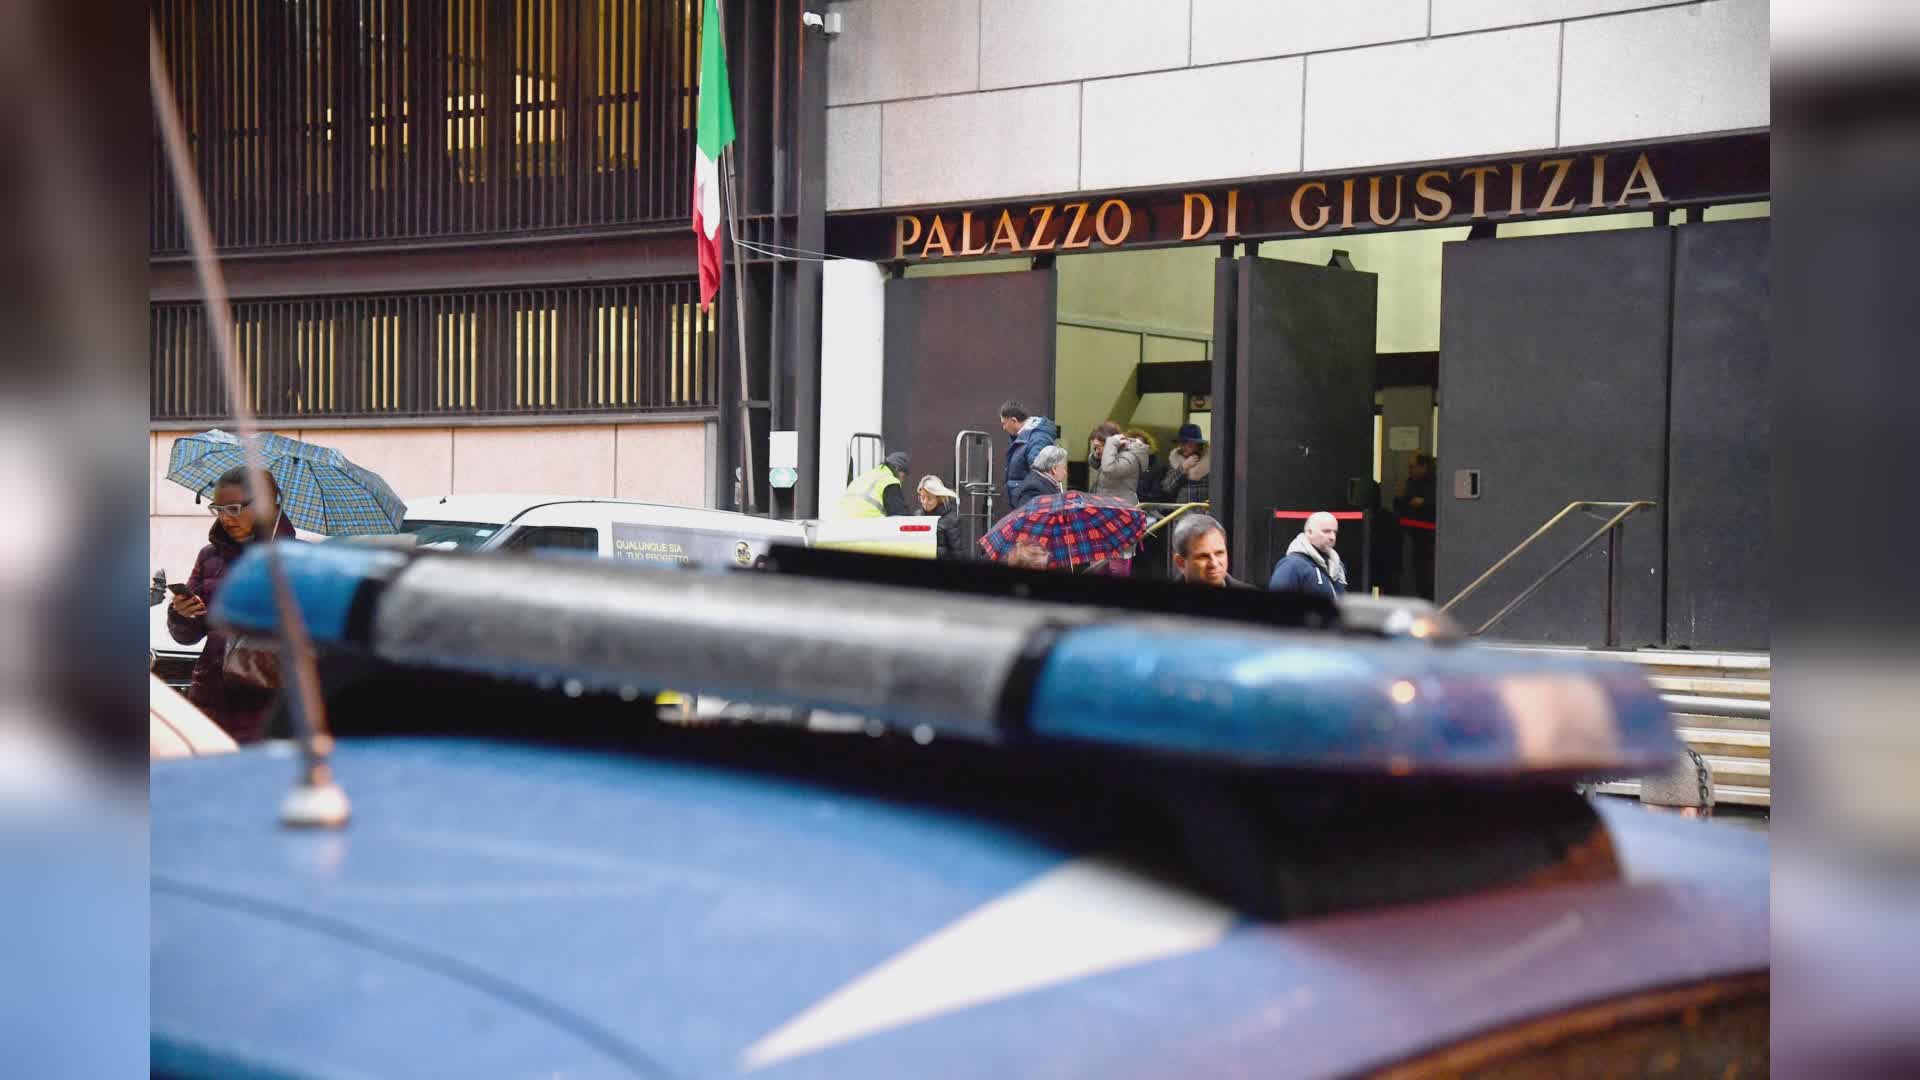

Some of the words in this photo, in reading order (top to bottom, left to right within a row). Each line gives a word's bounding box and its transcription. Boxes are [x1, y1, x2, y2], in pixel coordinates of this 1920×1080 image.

[894, 199, 1132, 260] PALAZZO
[1180, 191, 1241, 241] DI
[1290, 152, 1669, 232] GIUSTIZIA
[616, 540, 668, 552] QUALUNQUE
[669, 543, 682, 553] SIA
